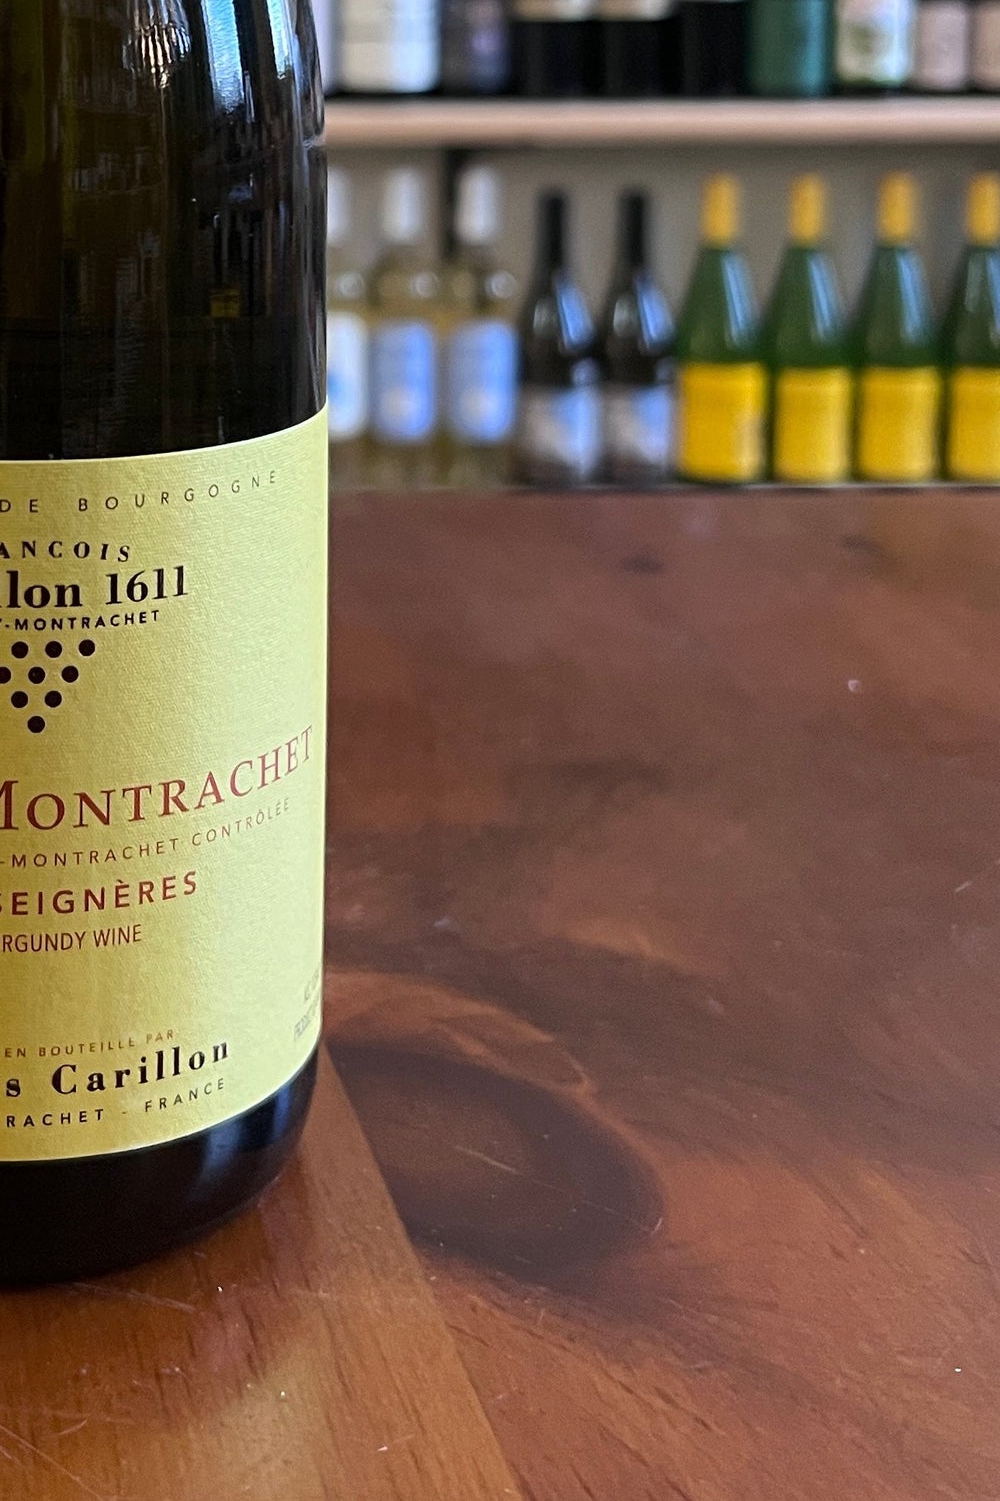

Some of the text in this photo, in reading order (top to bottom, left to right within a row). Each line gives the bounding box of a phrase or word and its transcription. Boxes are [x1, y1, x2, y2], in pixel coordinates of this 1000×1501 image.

[0, 499, 39, 513] DE
[78, 470, 276, 512] BOURGOGNE
[105, 565, 189, 606] 1611
[192, 796, 290, 847] CONTRÔLÉE
[93, 923, 142, 948] WINE
[5, 1046, 27, 1058] EN
[39, 1036, 136, 1058] BOUTEILLE
[146, 1029, 175, 1045] PAR
[51, 1040, 229, 1095] Carillon
[144, 1077, 226, 1114] FRANCE
